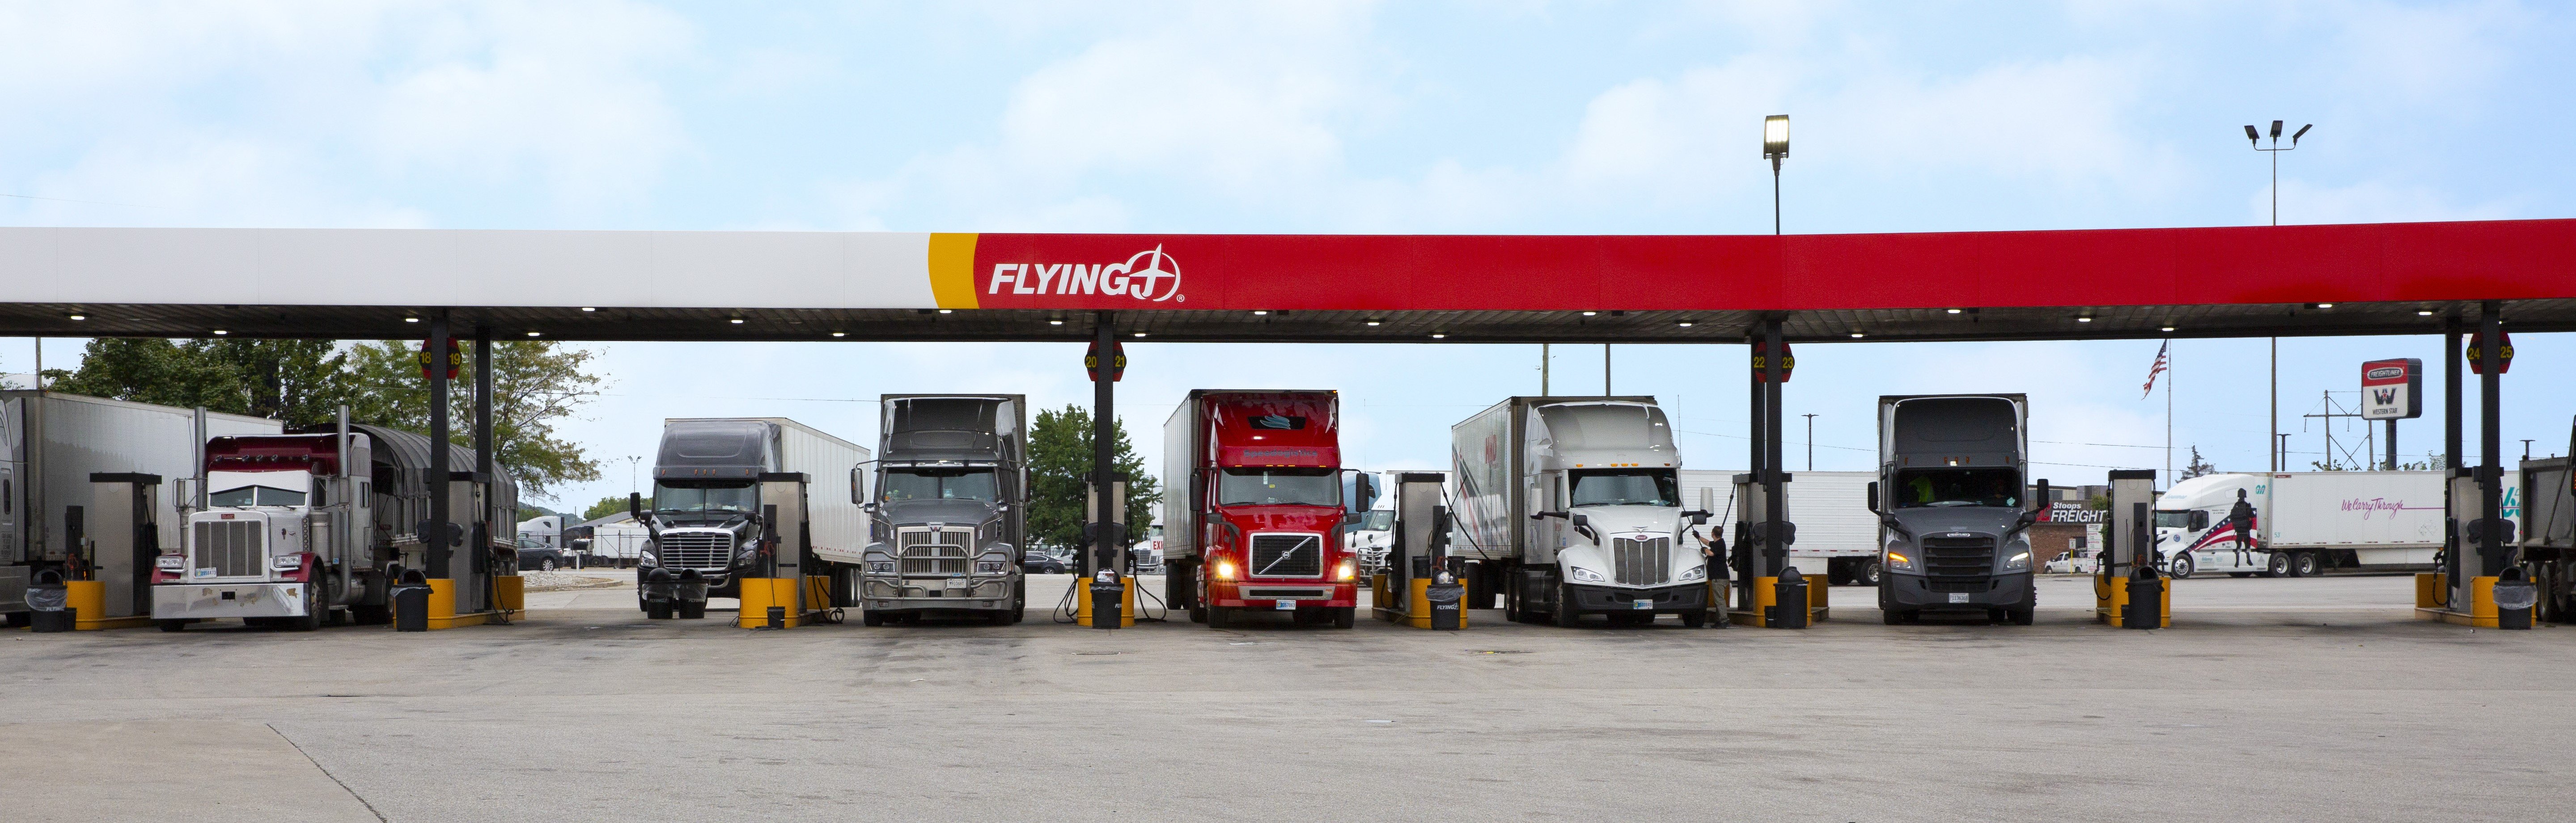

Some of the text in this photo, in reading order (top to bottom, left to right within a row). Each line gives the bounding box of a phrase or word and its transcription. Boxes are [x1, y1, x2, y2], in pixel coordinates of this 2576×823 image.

[989, 263, 1130, 295] FLYING
[420, 352, 432, 363] 18
[2469, 348, 2480, 360] 24
[2500, 346, 2512, 358] 25
[449, 353, 461, 365] 19
[1086, 356, 1097, 367] 20
[1115, 355, 1125, 367] 21
[1754, 356, 1765, 368] 22
[1783, 357, 1794, 368] 23
[2053, 502, 2081, 510] Stoops
[2342, 498, 2403, 520] We Carry Through
